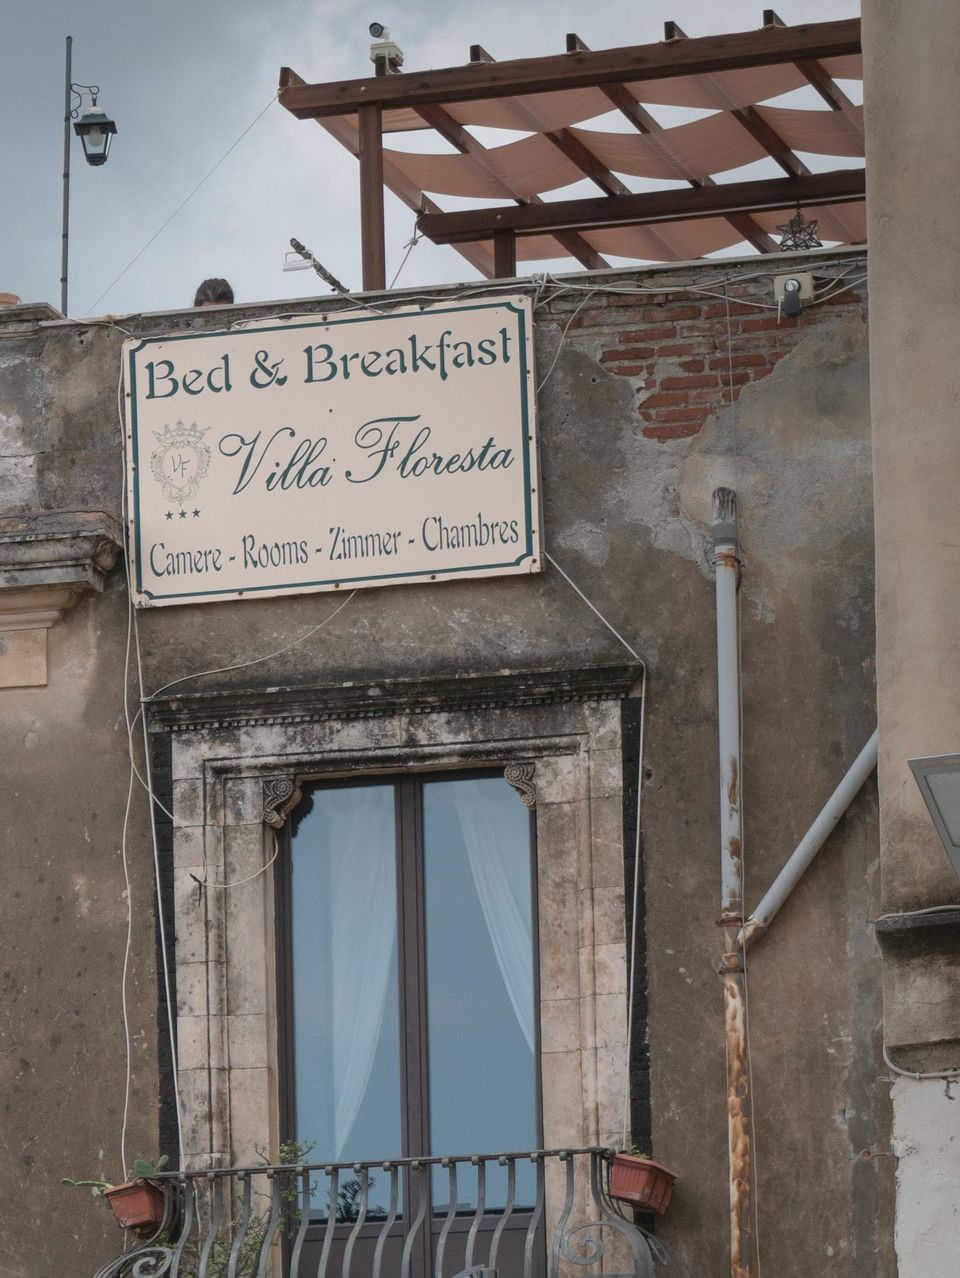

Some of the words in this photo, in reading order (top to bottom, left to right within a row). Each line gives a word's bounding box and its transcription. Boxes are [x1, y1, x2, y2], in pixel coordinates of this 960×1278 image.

[145, 355, 234, 399] Bed
[249, 349, 289, 389] &
[303, 327, 513, 383] Breakfast
[171, 454, 190, 479] VF
[218, 427, 334, 497] Villa
[344, 415, 516, 483] Floresta
[149, 542, 223, 578] Camere
[242, 534, 310, 570] Rooms
[329, 526, 402, 560] Zimmer
[422, 512, 520, 552] Chambres
